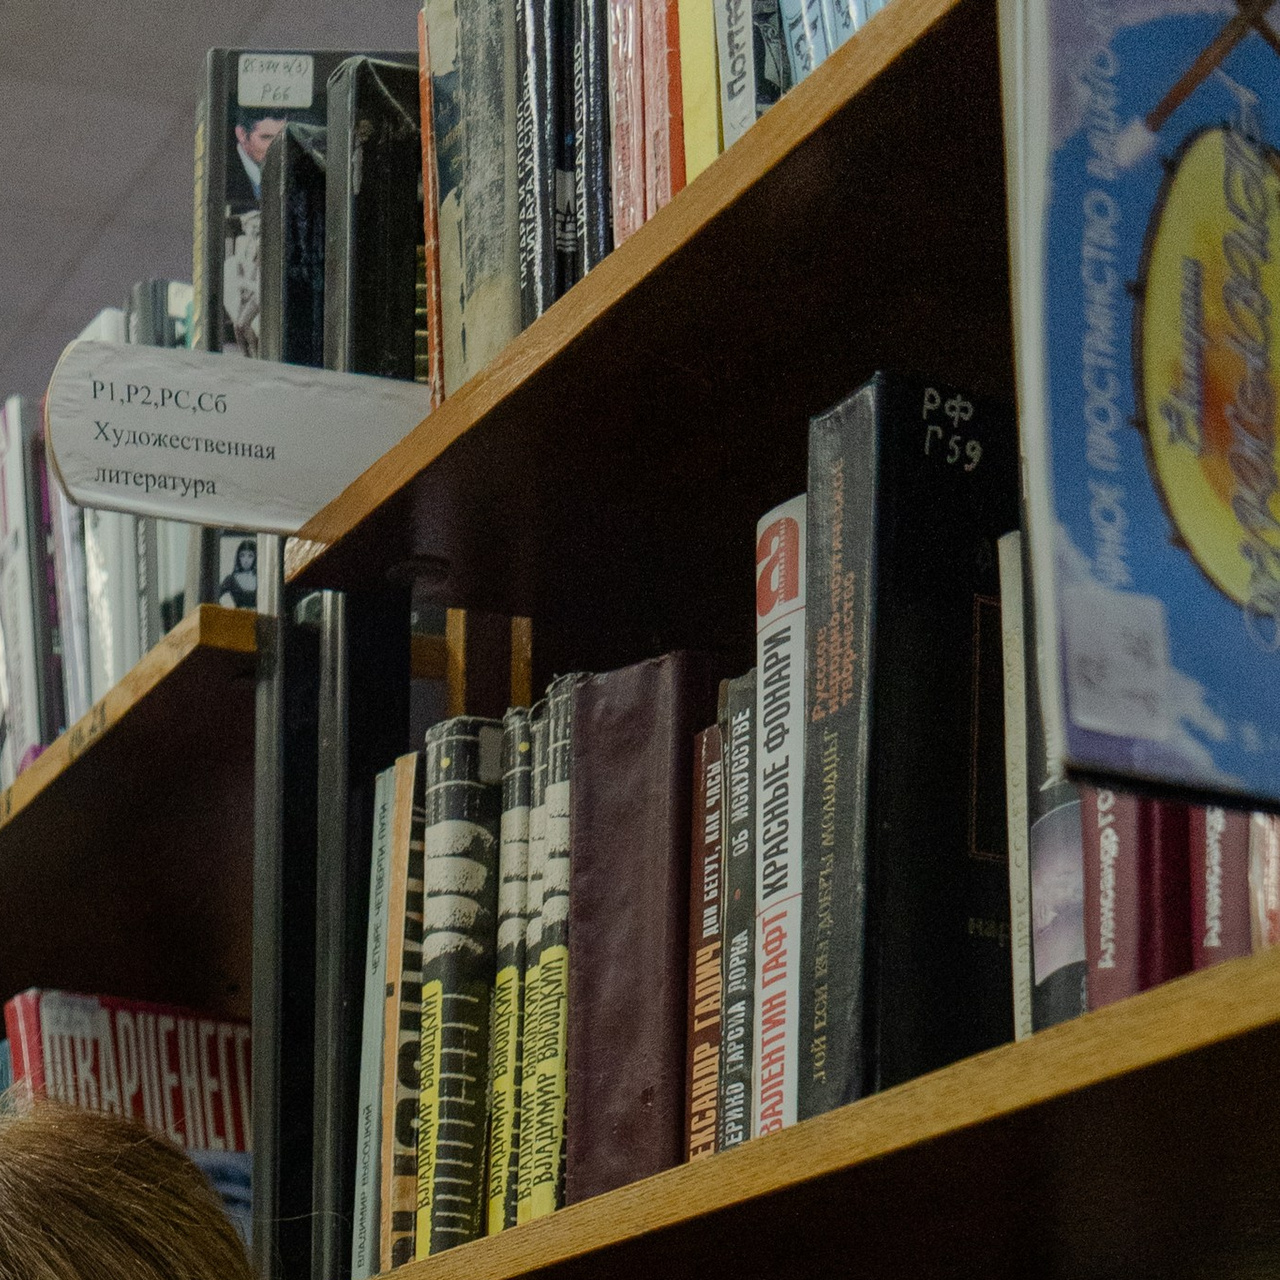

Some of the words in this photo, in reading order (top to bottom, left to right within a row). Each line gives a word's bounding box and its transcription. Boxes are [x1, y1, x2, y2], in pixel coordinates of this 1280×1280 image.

[93, 419, 276, 462] Художественная
[94, 465, 217, 499] литература
[762, 625, 792, 750] ФОНАРИ
[705, 760, 722, 808] ЧАСЫ
[730, 706, 751, 822] ИСКУССТВЕ
[704, 810, 721, 844] КАК
[761, 756, 791, 899] КРАСНЫЕ
[1097, 787, 1116, 827] ГО
[702, 846, 721, 902] БЕГУТ,
[731, 829, 750, 858] ОБ
[701, 904, 720, 938] ДНИ
[760, 909, 789, 989] ГАФТ
[694, 939, 722, 1033] ГАЛИЧ
[727, 929, 750, 993] ЛОРКА
[726, 1000, 747, 1074] ГАРСИА
[532, 1073, 561, 1187] ВЛАДИМИР
[689, 1041, 719, 1160] ЕКСАНДР
[725, 1081, 745, 1145] ЕРИКО
[417, 1101, 435, 1210] ВЛАДИМИР
[489, 1090, 509, 1200] ВЛАДИМИР
